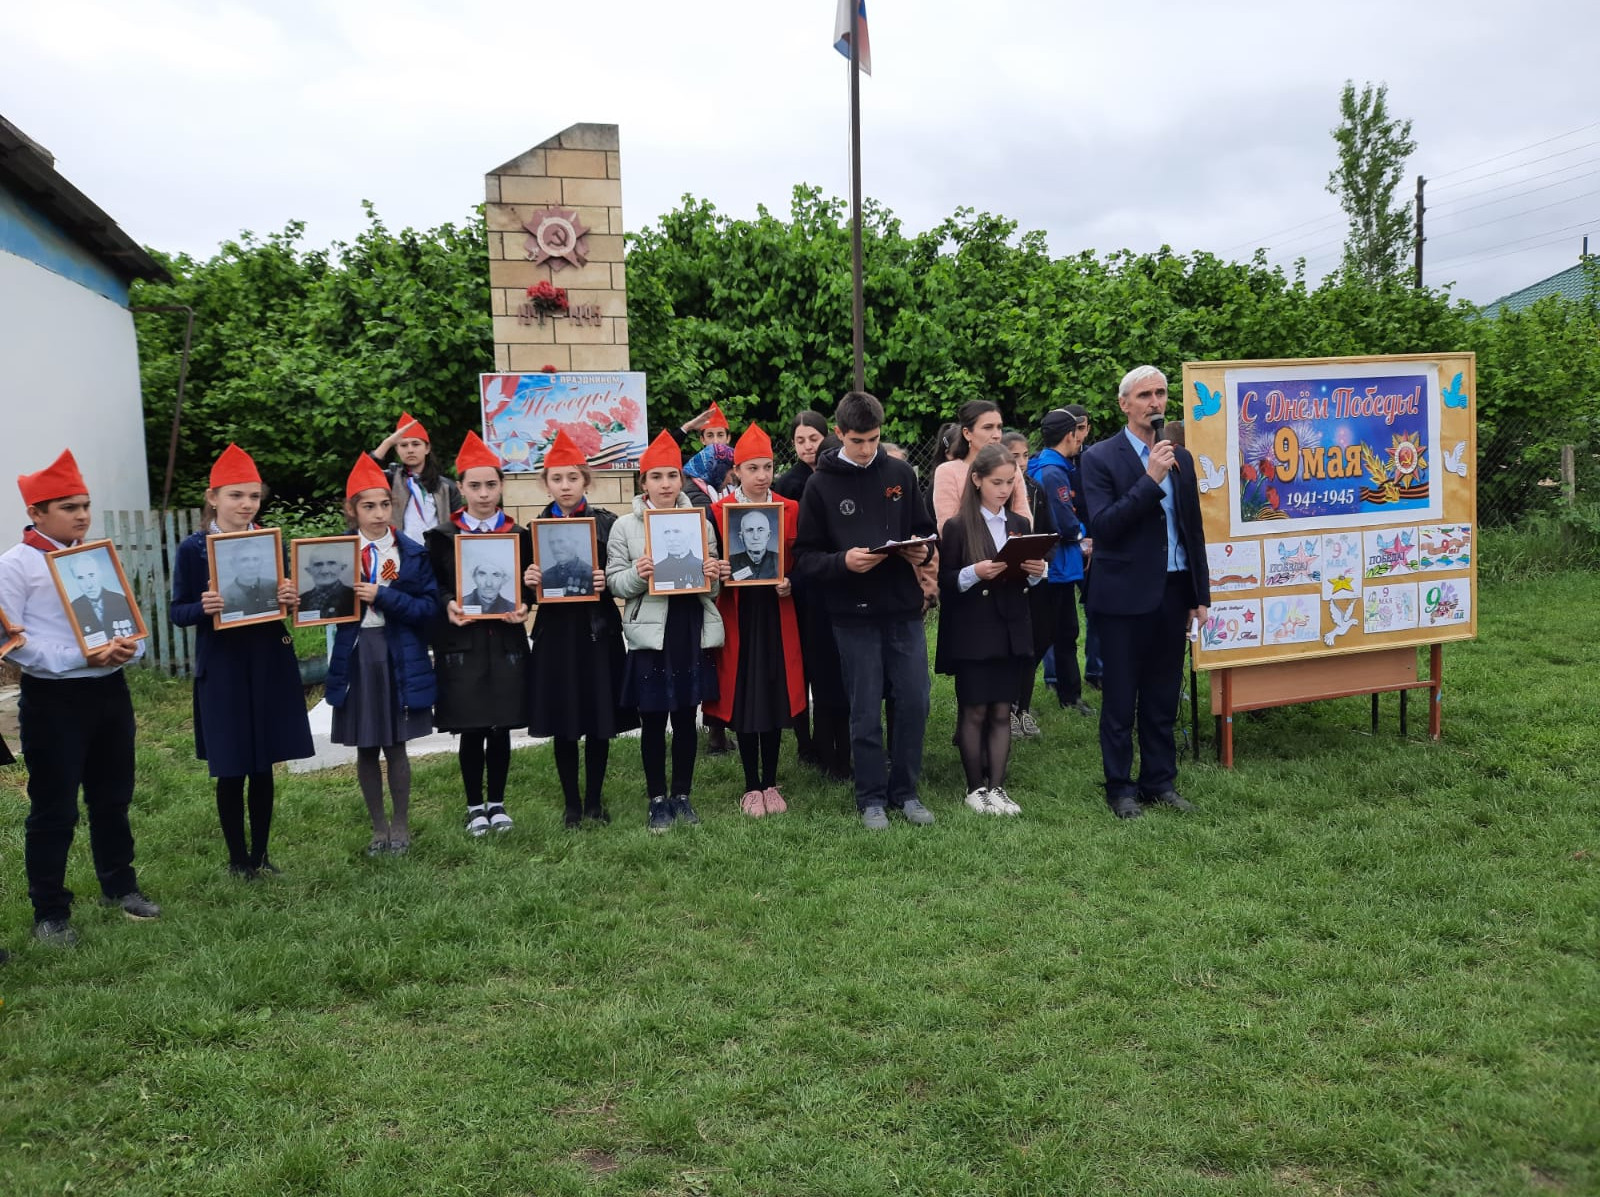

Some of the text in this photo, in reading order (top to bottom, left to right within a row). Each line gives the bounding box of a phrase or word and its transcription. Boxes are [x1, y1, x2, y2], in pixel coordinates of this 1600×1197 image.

[1241, 385, 1422, 426] С Днём Победы!
[1274, 426, 1363, 483] 9 мая
[1287, 488, 1355, 508] 1941-1945
[1225, 544, 1233, 557] 9
[1382, 587, 1390, 598] 9
[1425, 587, 1441, 613] 9
